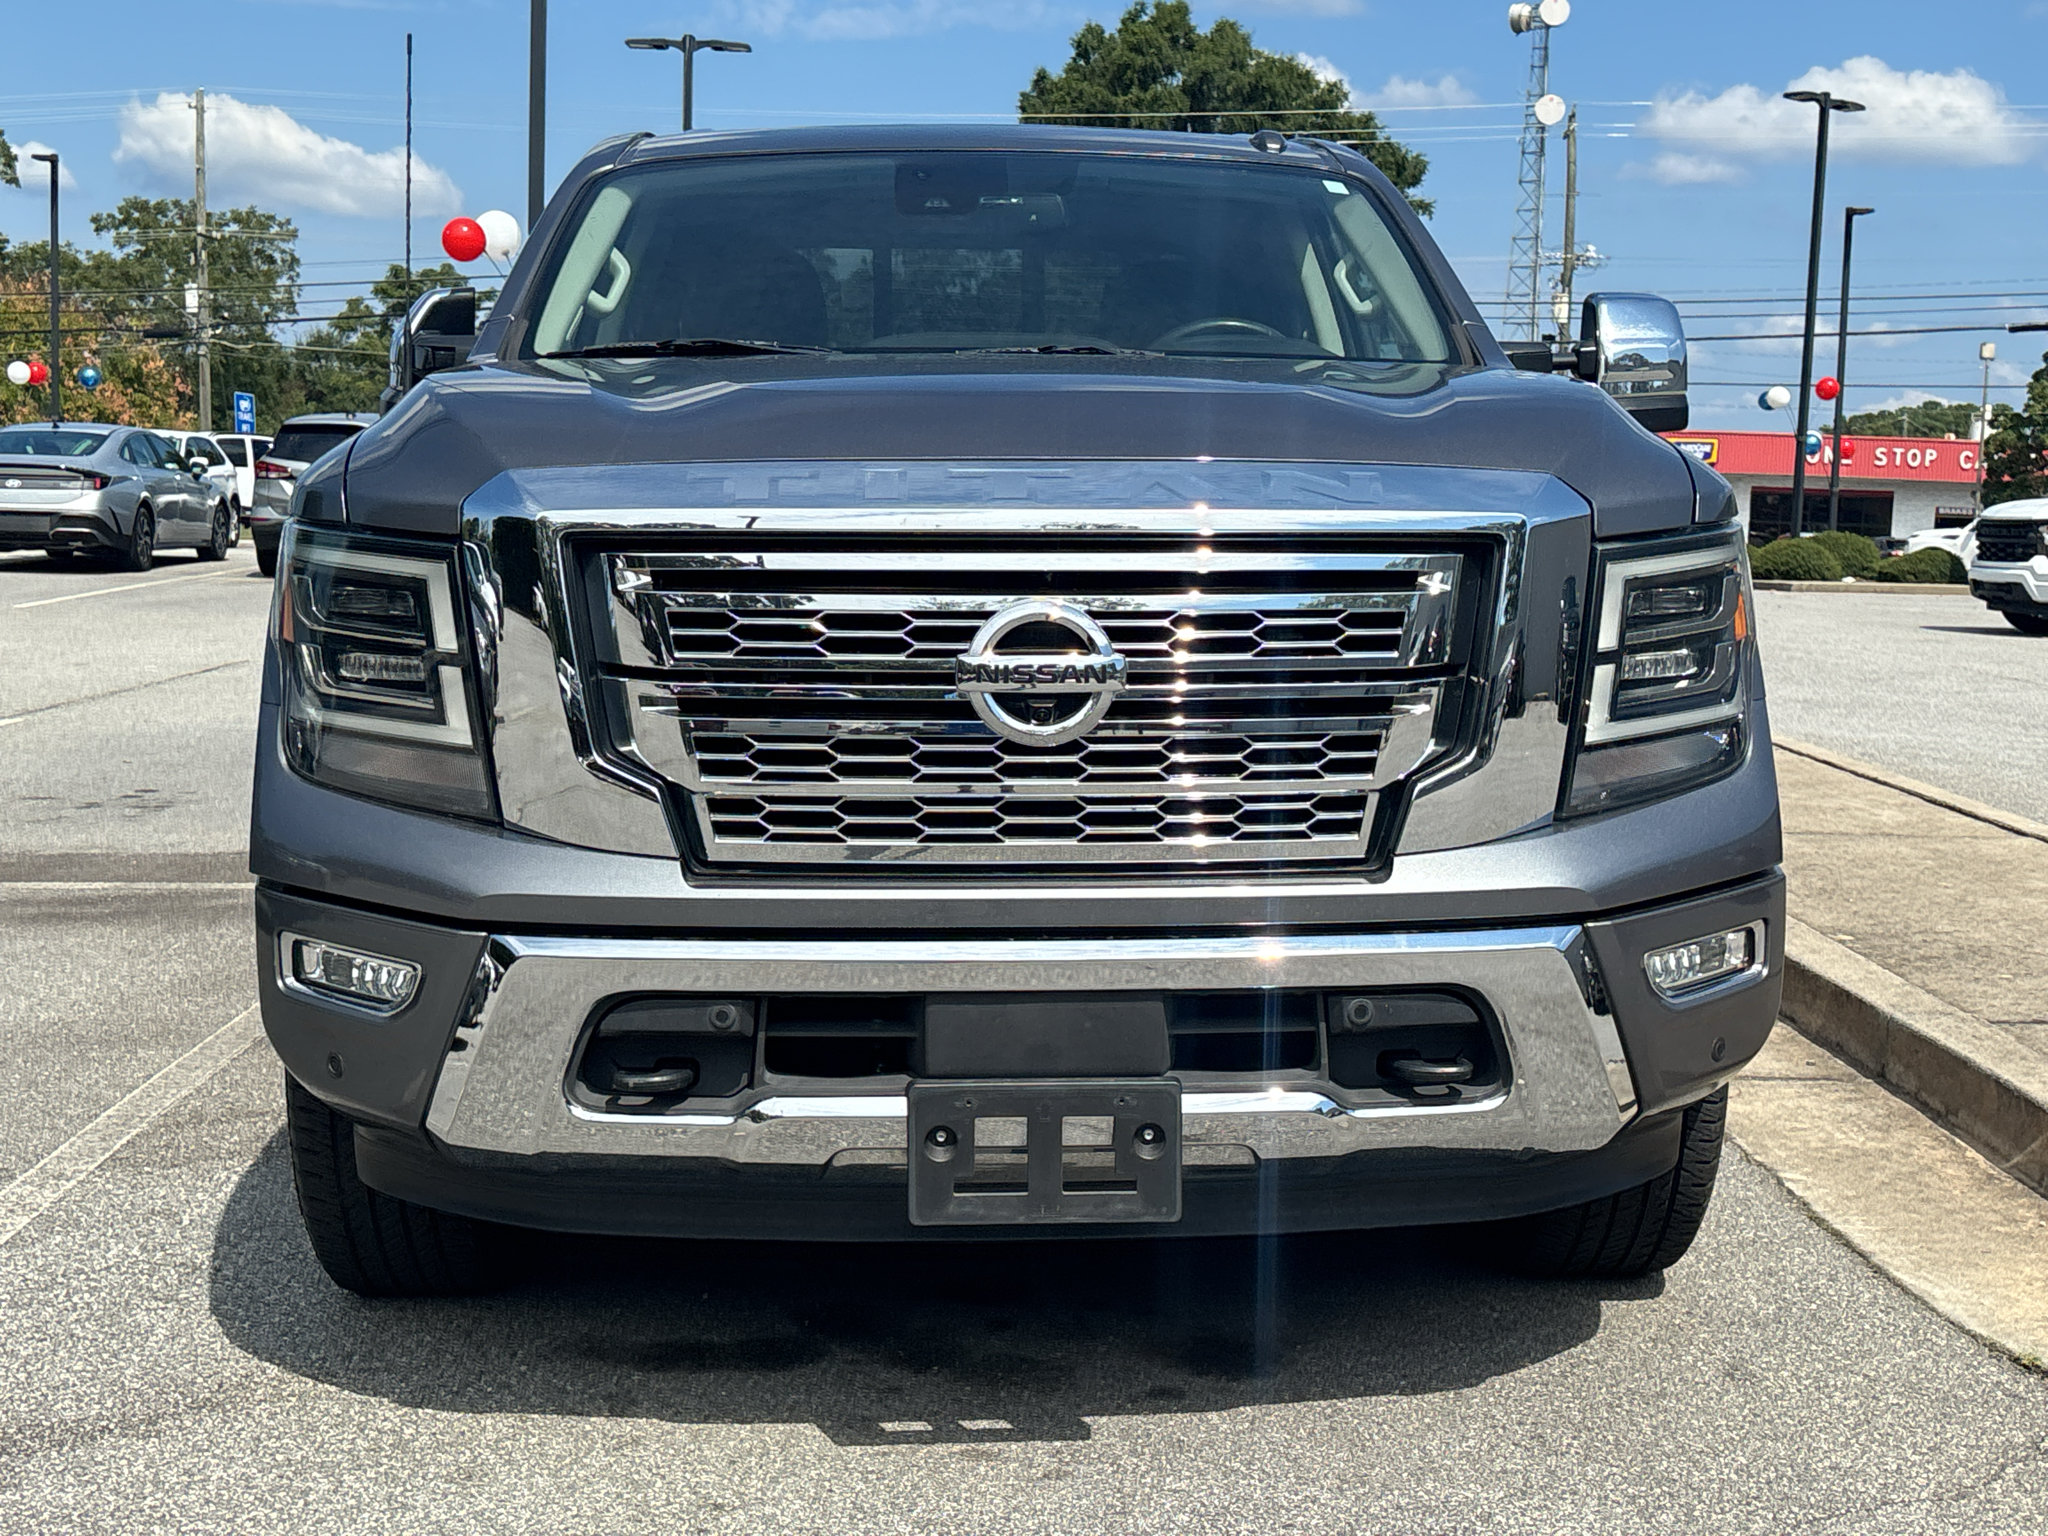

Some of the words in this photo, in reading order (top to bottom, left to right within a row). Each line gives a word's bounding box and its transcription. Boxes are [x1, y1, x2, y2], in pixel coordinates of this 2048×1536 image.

[1805, 444, 1853, 465] ON
[1873, 446, 1938, 468] STOP
[686, 467, 1384, 505] TITAN
[975, 664, 1108, 684] NISSAN
